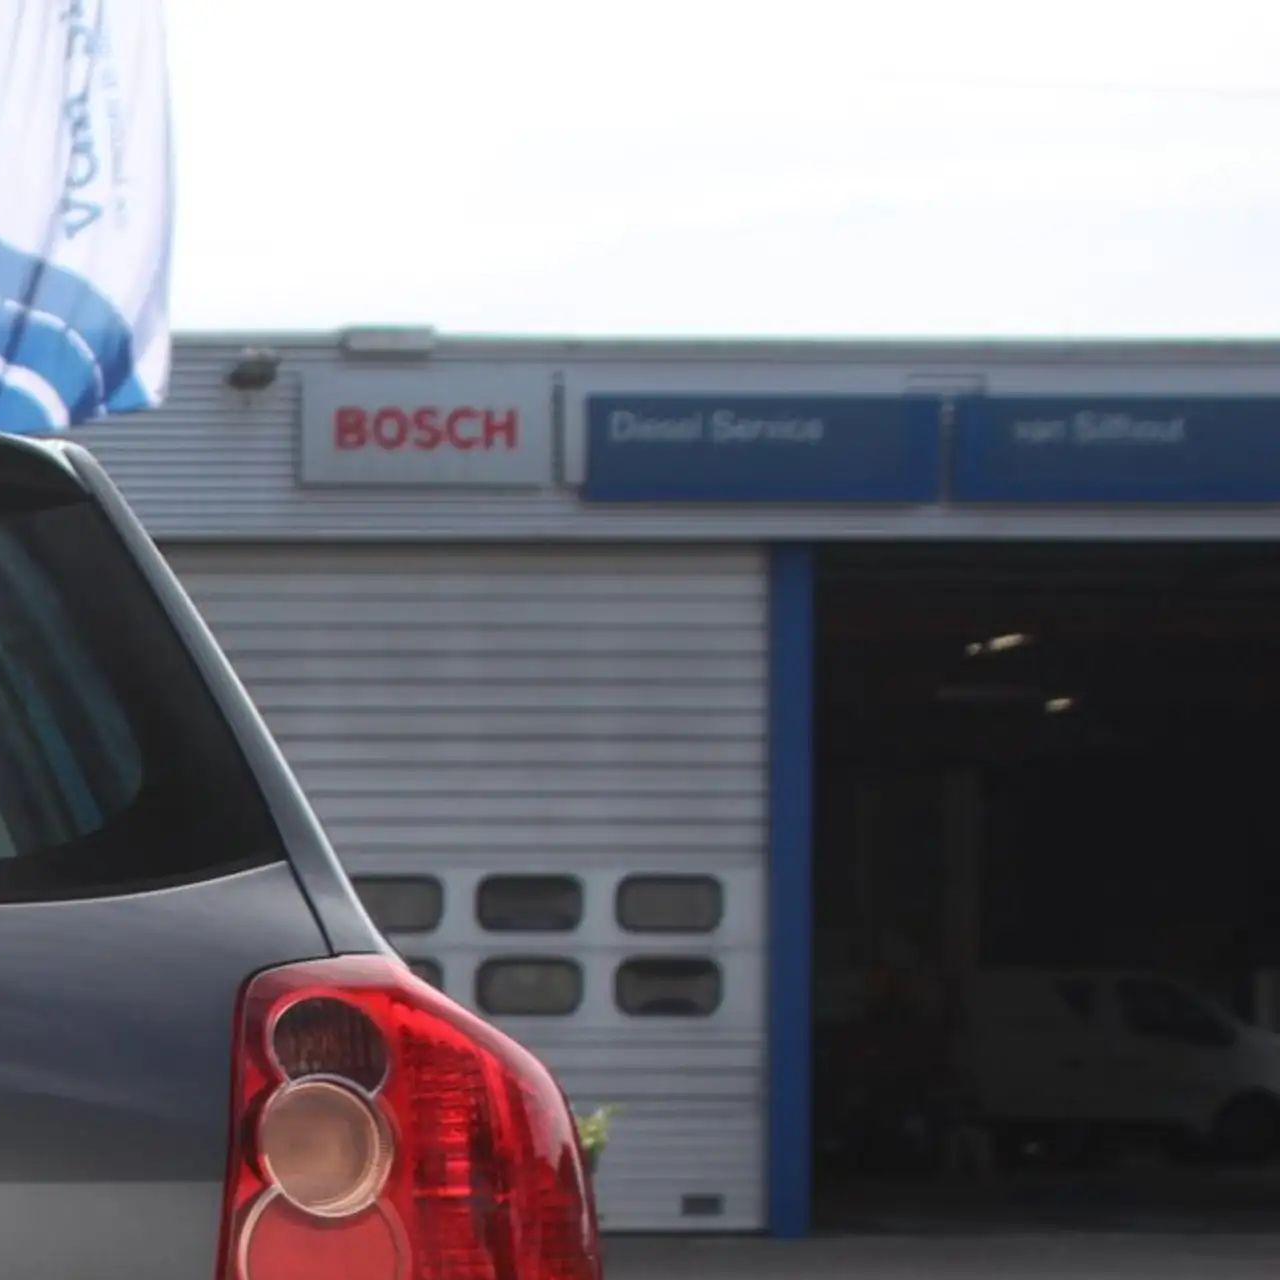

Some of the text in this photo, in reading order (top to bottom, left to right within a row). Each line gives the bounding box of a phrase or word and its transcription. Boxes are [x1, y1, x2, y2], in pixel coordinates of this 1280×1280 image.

[333, 406, 519, 451] BOSCH
[609, 409, 824, 442] Diesel Service
